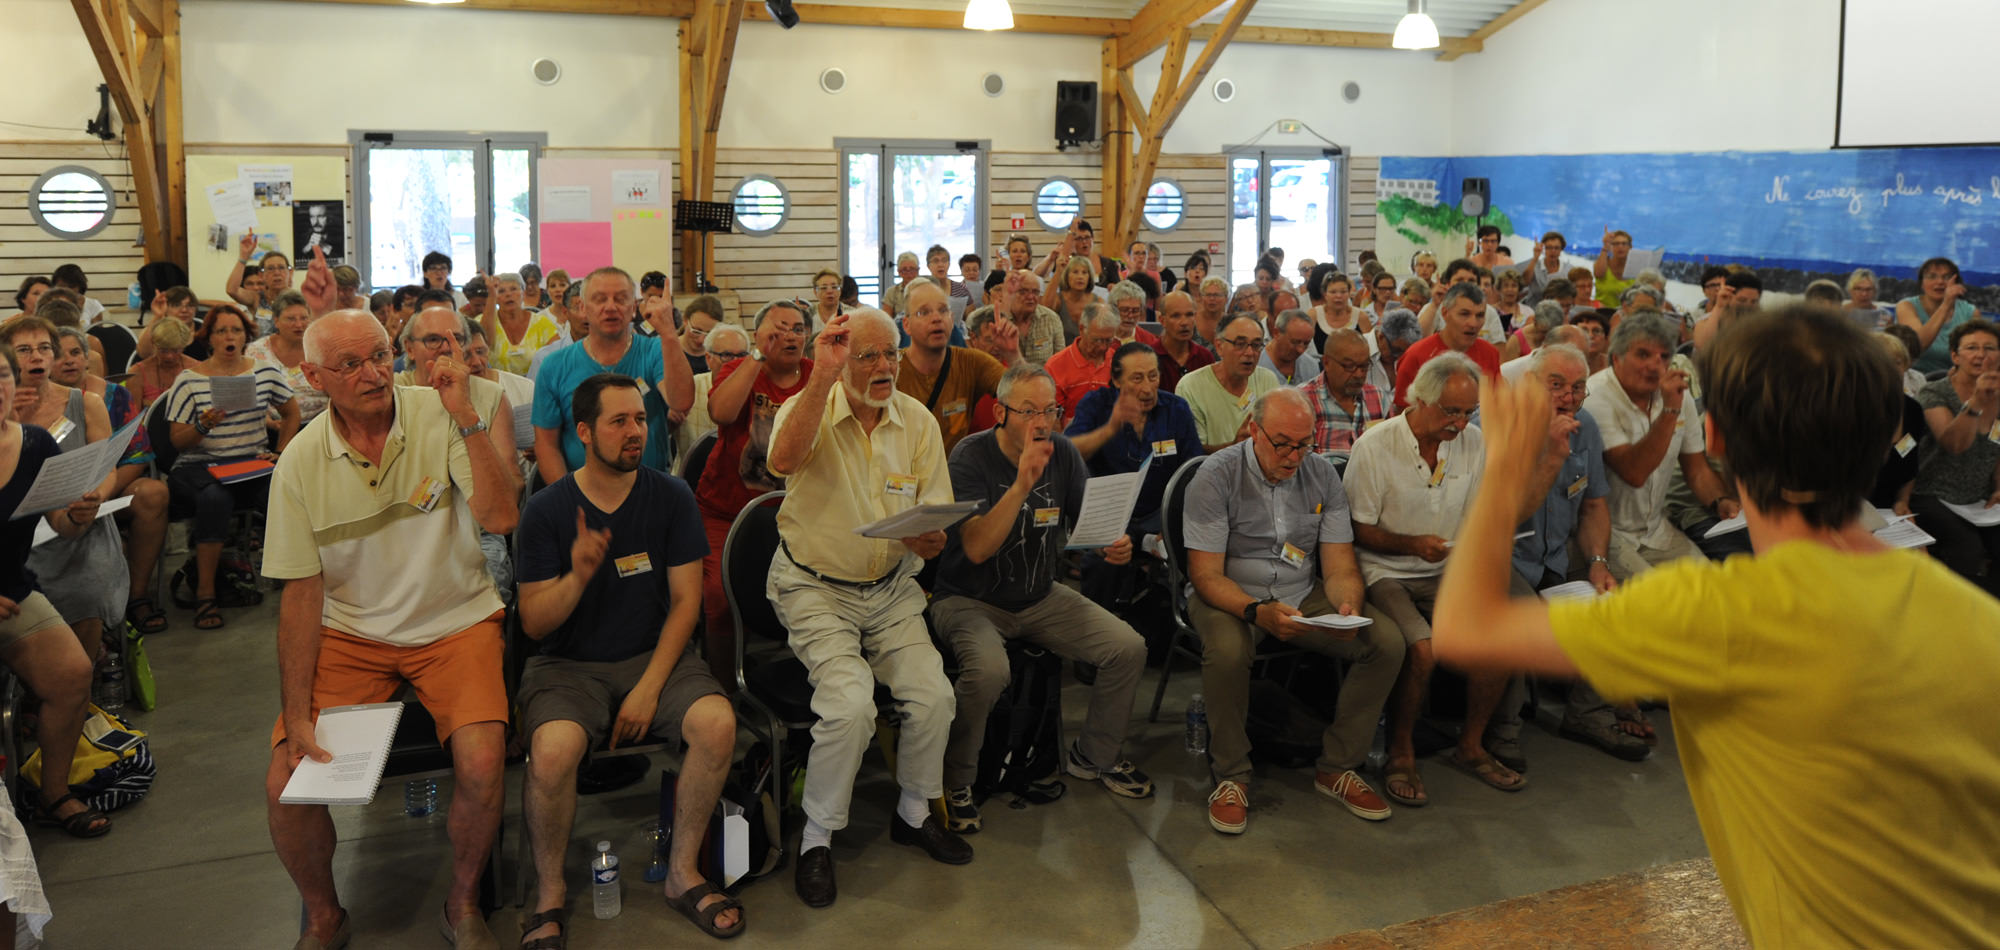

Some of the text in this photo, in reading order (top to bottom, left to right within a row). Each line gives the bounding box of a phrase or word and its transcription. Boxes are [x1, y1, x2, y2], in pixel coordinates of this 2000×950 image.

[1765, 175, 1791, 203] Ne
[1881, 172, 1923, 207] plus
[1933, 184, 1983, 206] après
